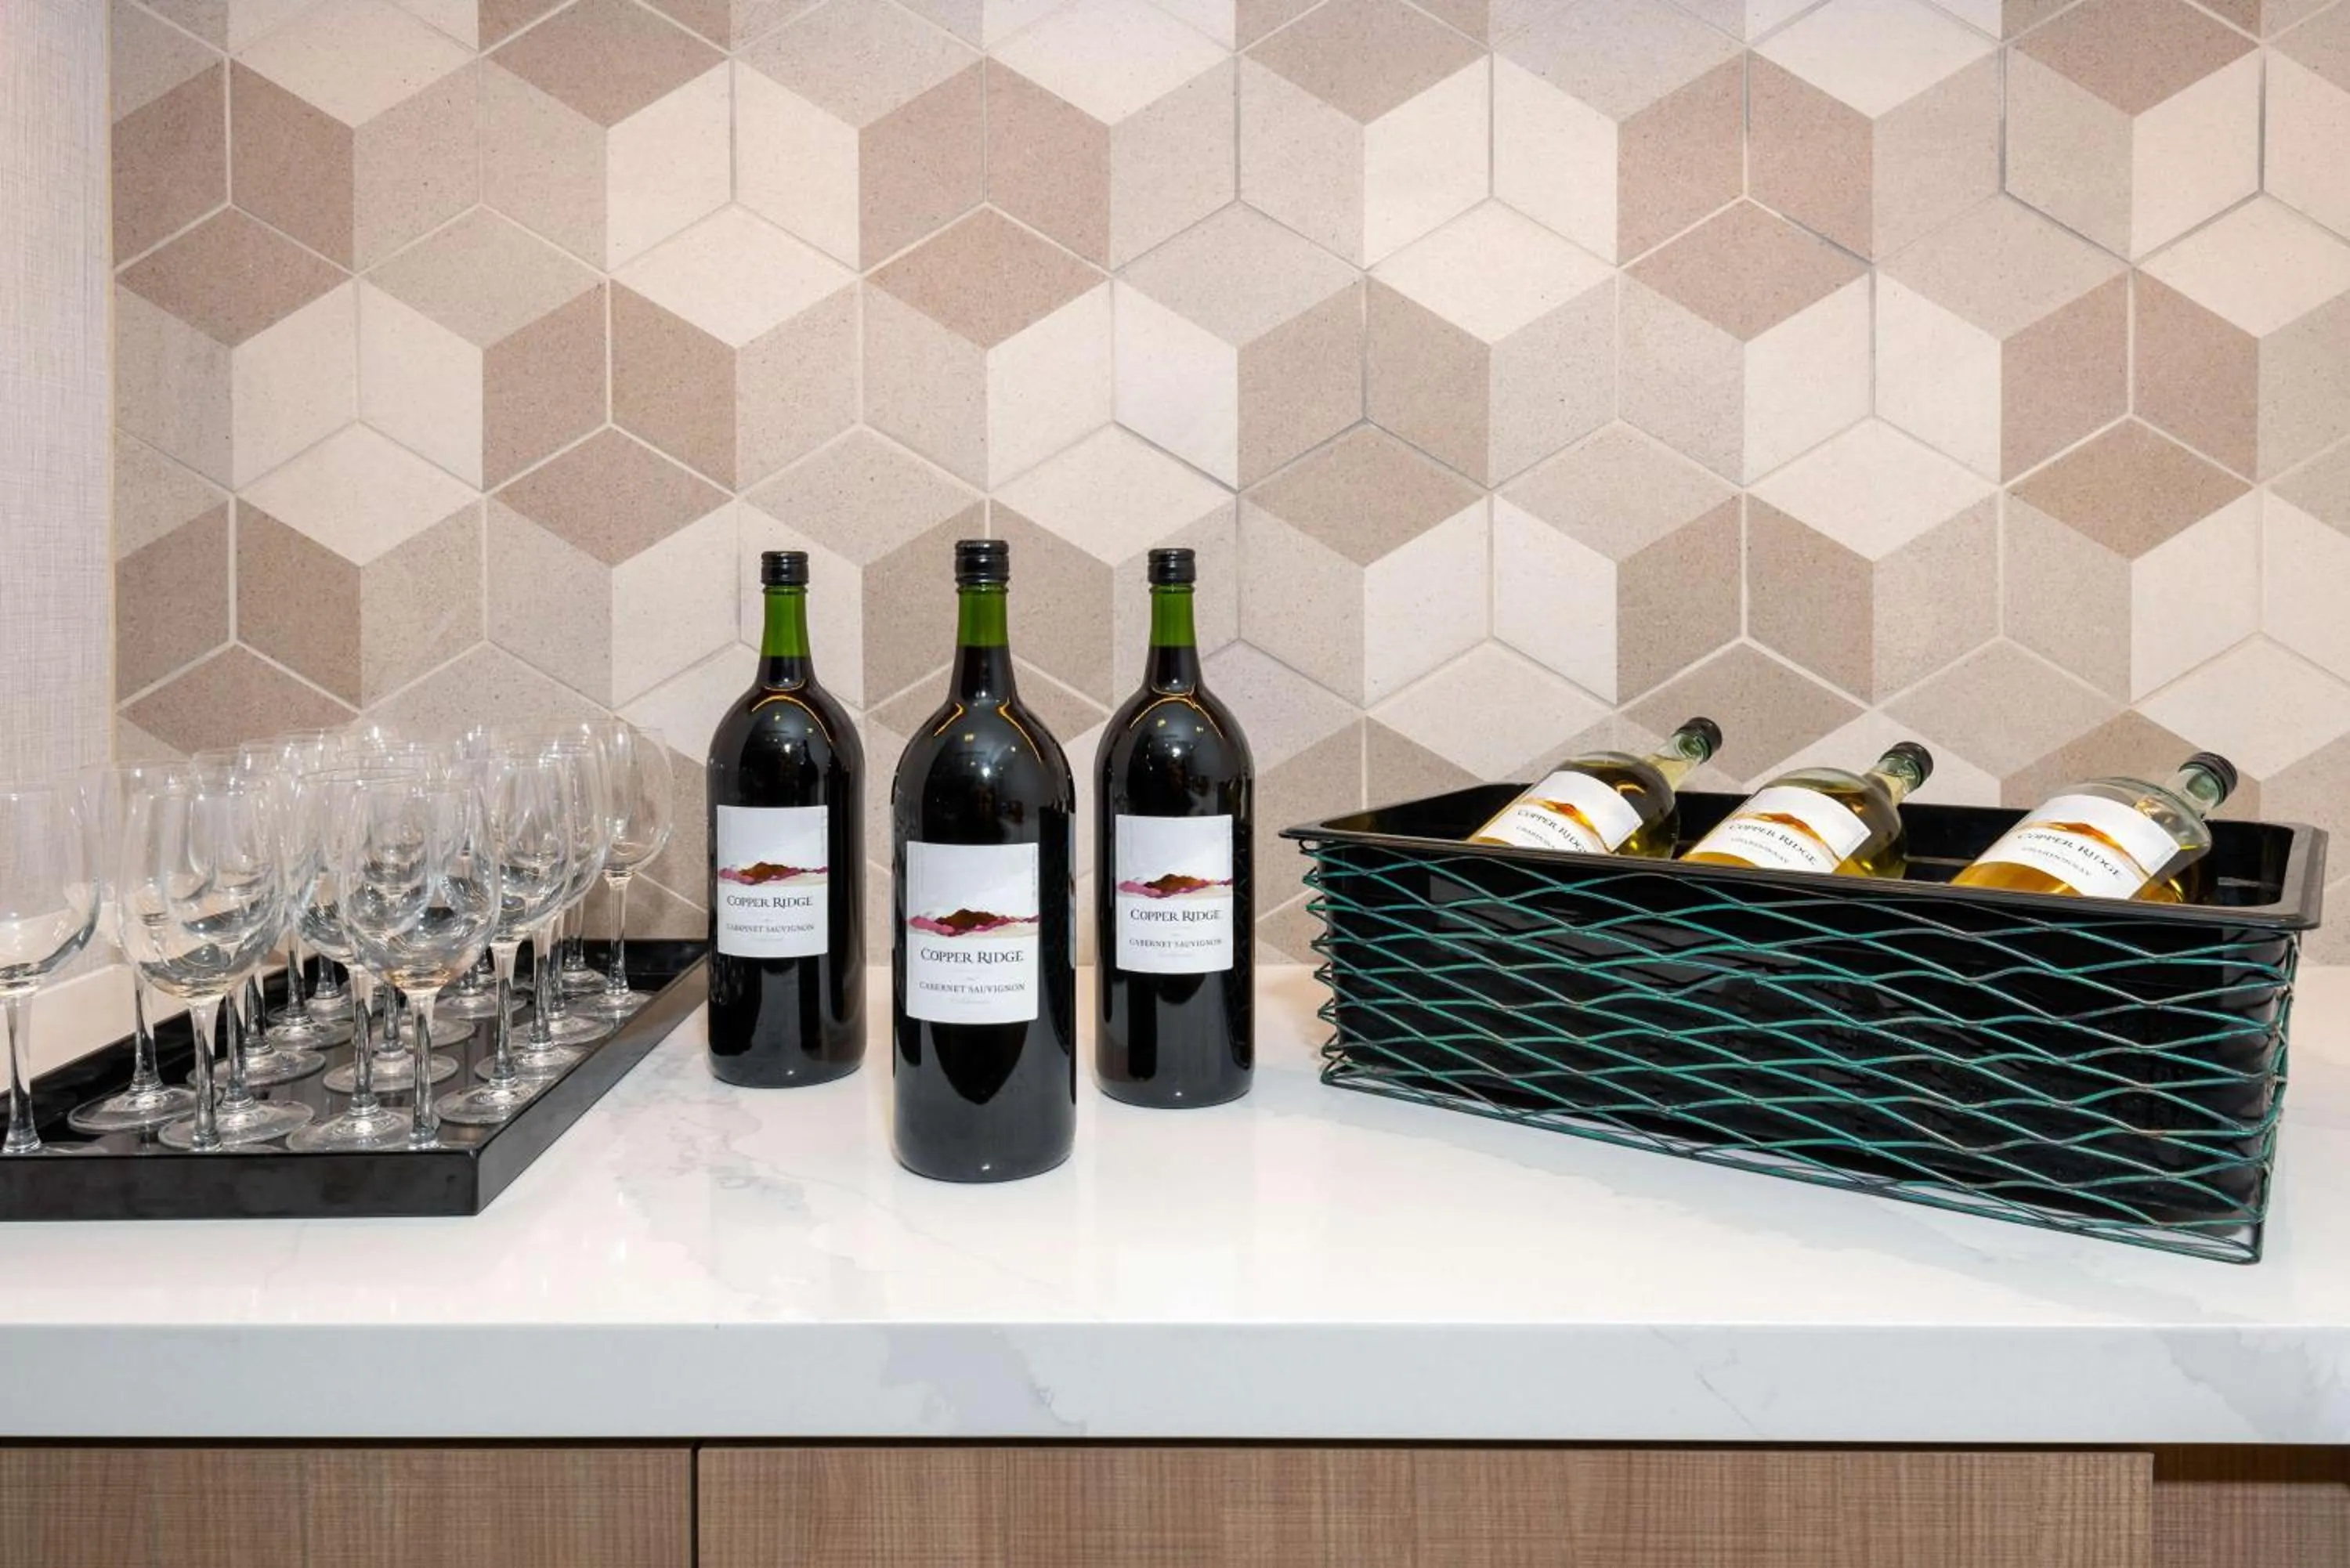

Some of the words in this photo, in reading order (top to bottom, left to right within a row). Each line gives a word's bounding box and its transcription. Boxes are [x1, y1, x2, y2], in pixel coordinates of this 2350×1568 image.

[1517, 808, 1558, 830] COPPER
[1729, 824, 1776, 838] COPPER
[1778, 833, 1817, 866] RIDGE
[2017, 833, 2073, 848] COPPER
[2077, 845, 2120, 876] RIDGE
[726, 895, 768, 908] COPPER
[773, 896, 813, 909] RIDGE
[1130, 909, 1179, 922] COPPER
[1182, 909, 1222, 922] RIDGE
[766, 923, 815, 934] SAUVIGNON
[920, 948, 973, 963] COPPER
[978, 949, 1025, 963] RIDGE
[918, 980, 966, 994] CABERNET
[967, 981, 1025, 994] SAUVIGNON
